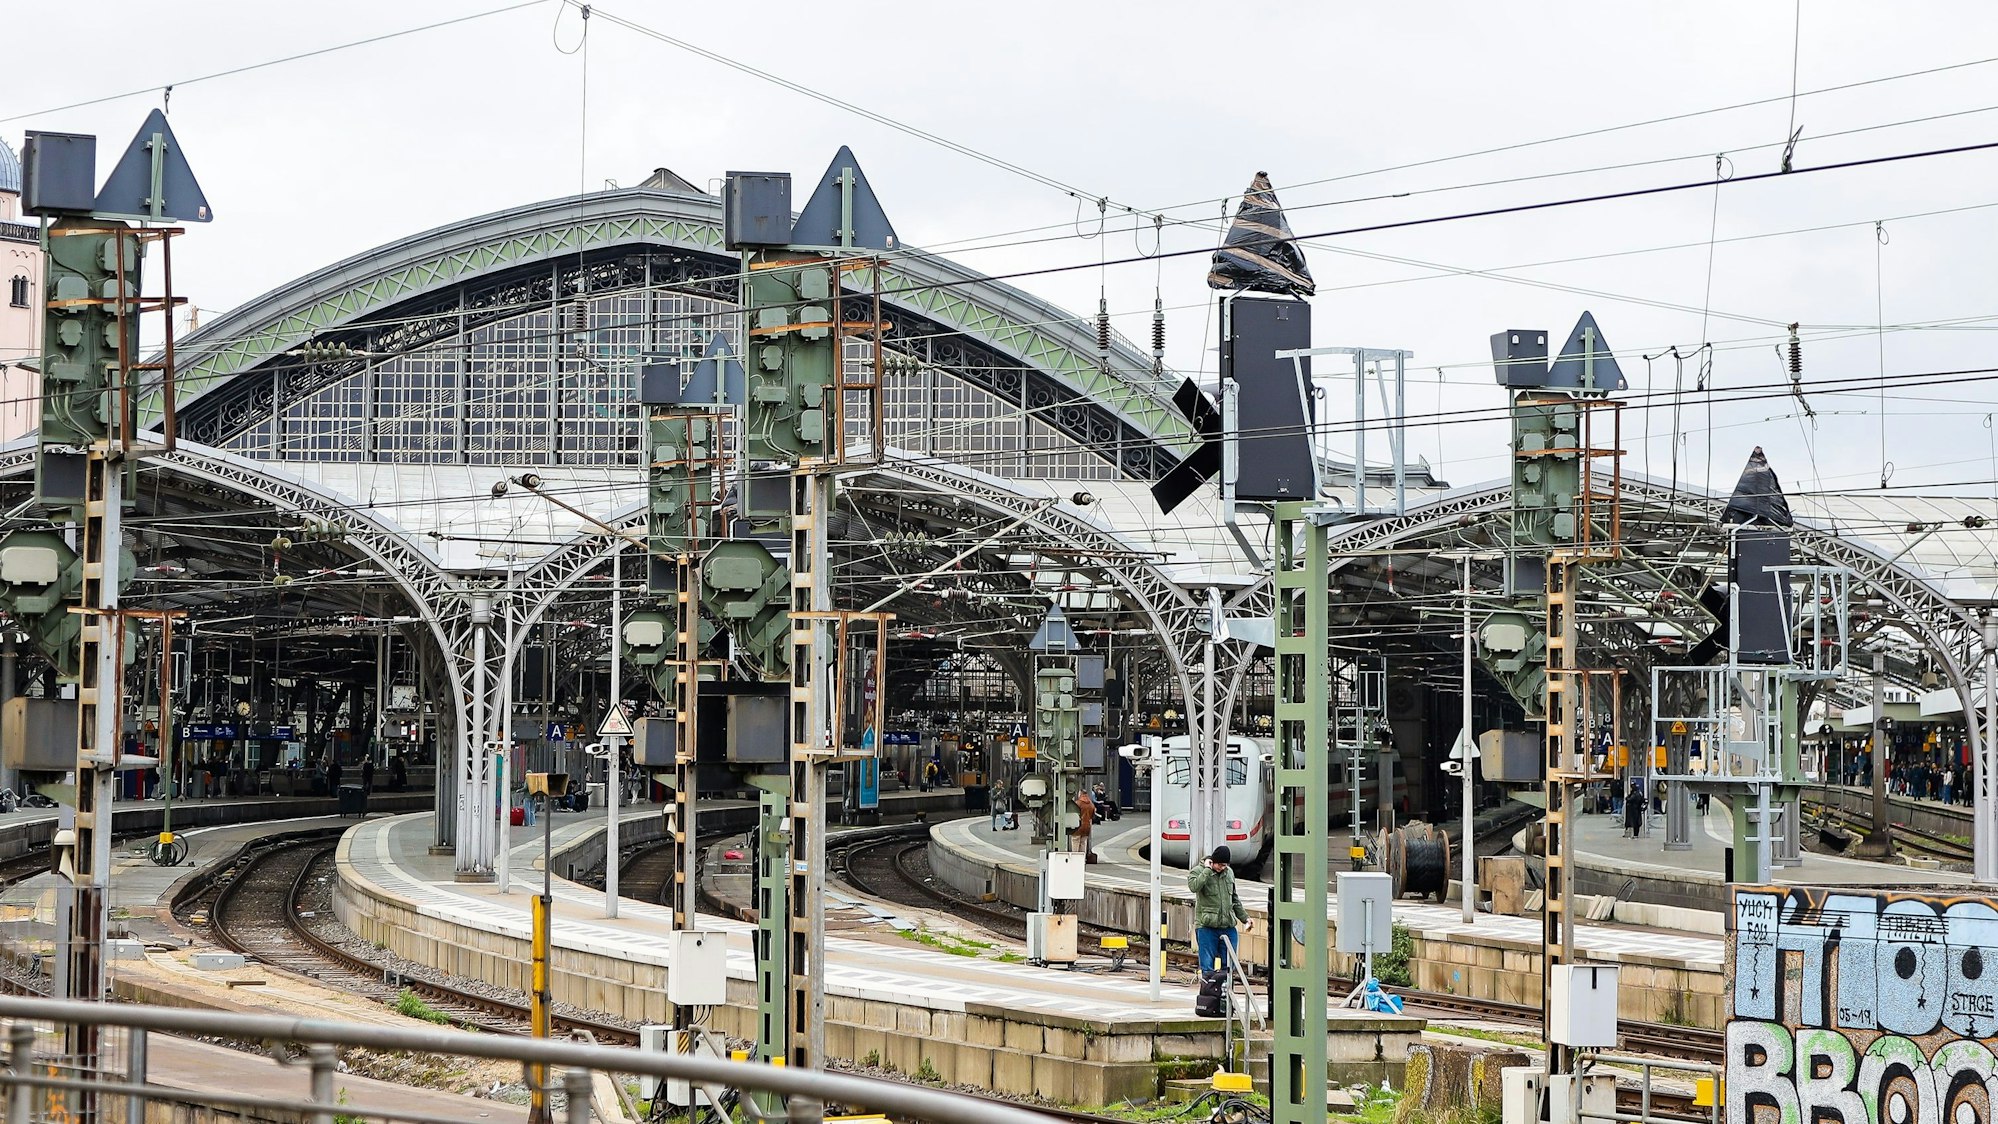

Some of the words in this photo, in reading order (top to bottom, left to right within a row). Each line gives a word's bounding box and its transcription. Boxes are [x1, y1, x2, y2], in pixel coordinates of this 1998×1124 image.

[1604, 713, 1611, 723] 8
[182, 727, 191, 738] B
[551, 725, 562, 738] A
[1012, 724, 1023, 736] A
[1602, 732, 1613, 746] A
[1896, 735, 1903, 744] B
[1739, 898, 1773, 920] YUCK
